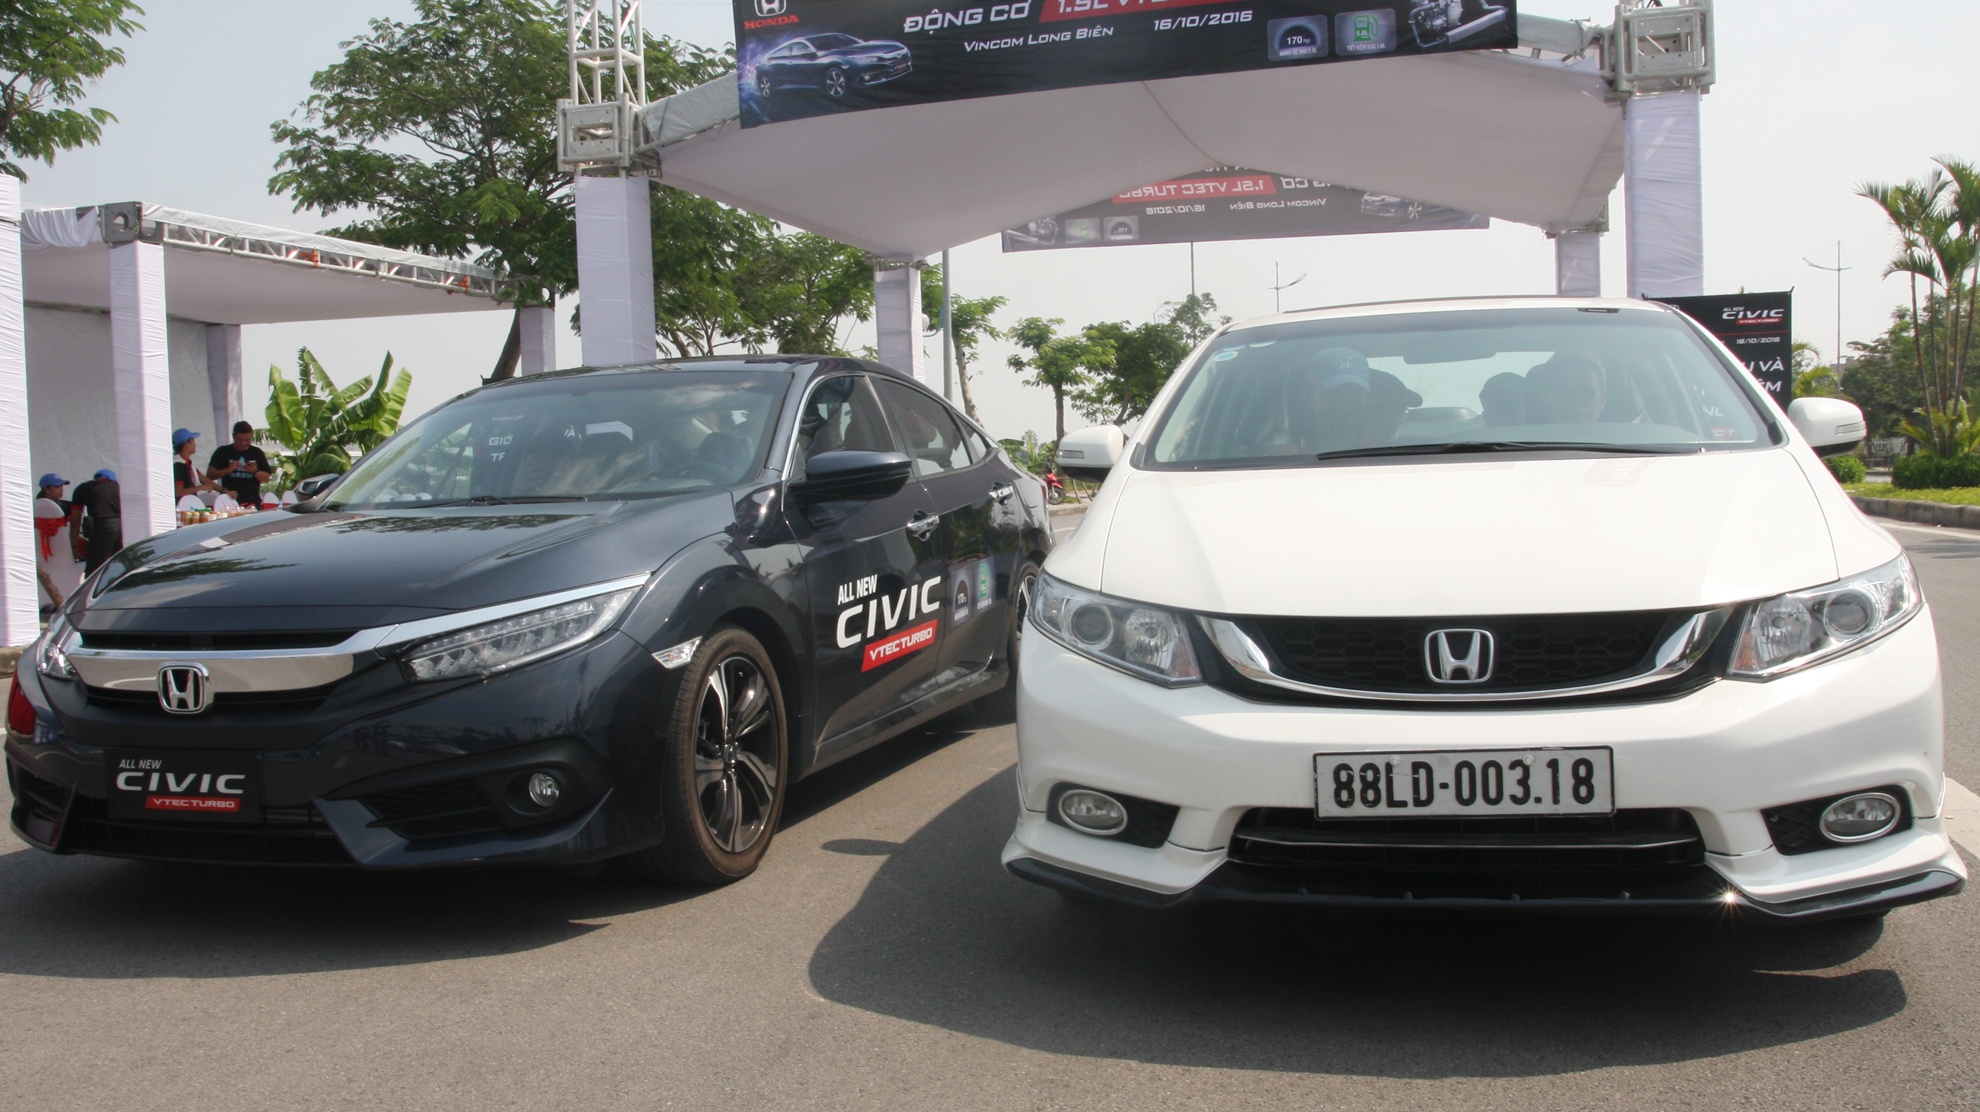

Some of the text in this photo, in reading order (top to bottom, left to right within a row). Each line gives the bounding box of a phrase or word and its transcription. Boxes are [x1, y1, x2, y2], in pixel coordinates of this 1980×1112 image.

[743, 14, 800, 29] HONDA
[903, 8, 984, 35] ĐỘNG
[990, 0, 1032, 21] CƠ
[1153, 10, 1253, 31] 16/10/2016
[1287, 35, 1303, 45] 170
[1721, 308, 1785, 320] CIVIC
[1736, 336, 1781, 345] 16/10/2016
[1758, 356, 1785, 372] VÀ
[837, 573, 878, 606] ALL NEW
[836, 575, 942, 649] CIVIC
[118, 759, 163, 770] ALL NEW
[116, 771, 247, 795] CIVIC
[1333, 757, 1595, 808] 88LD-003.18
